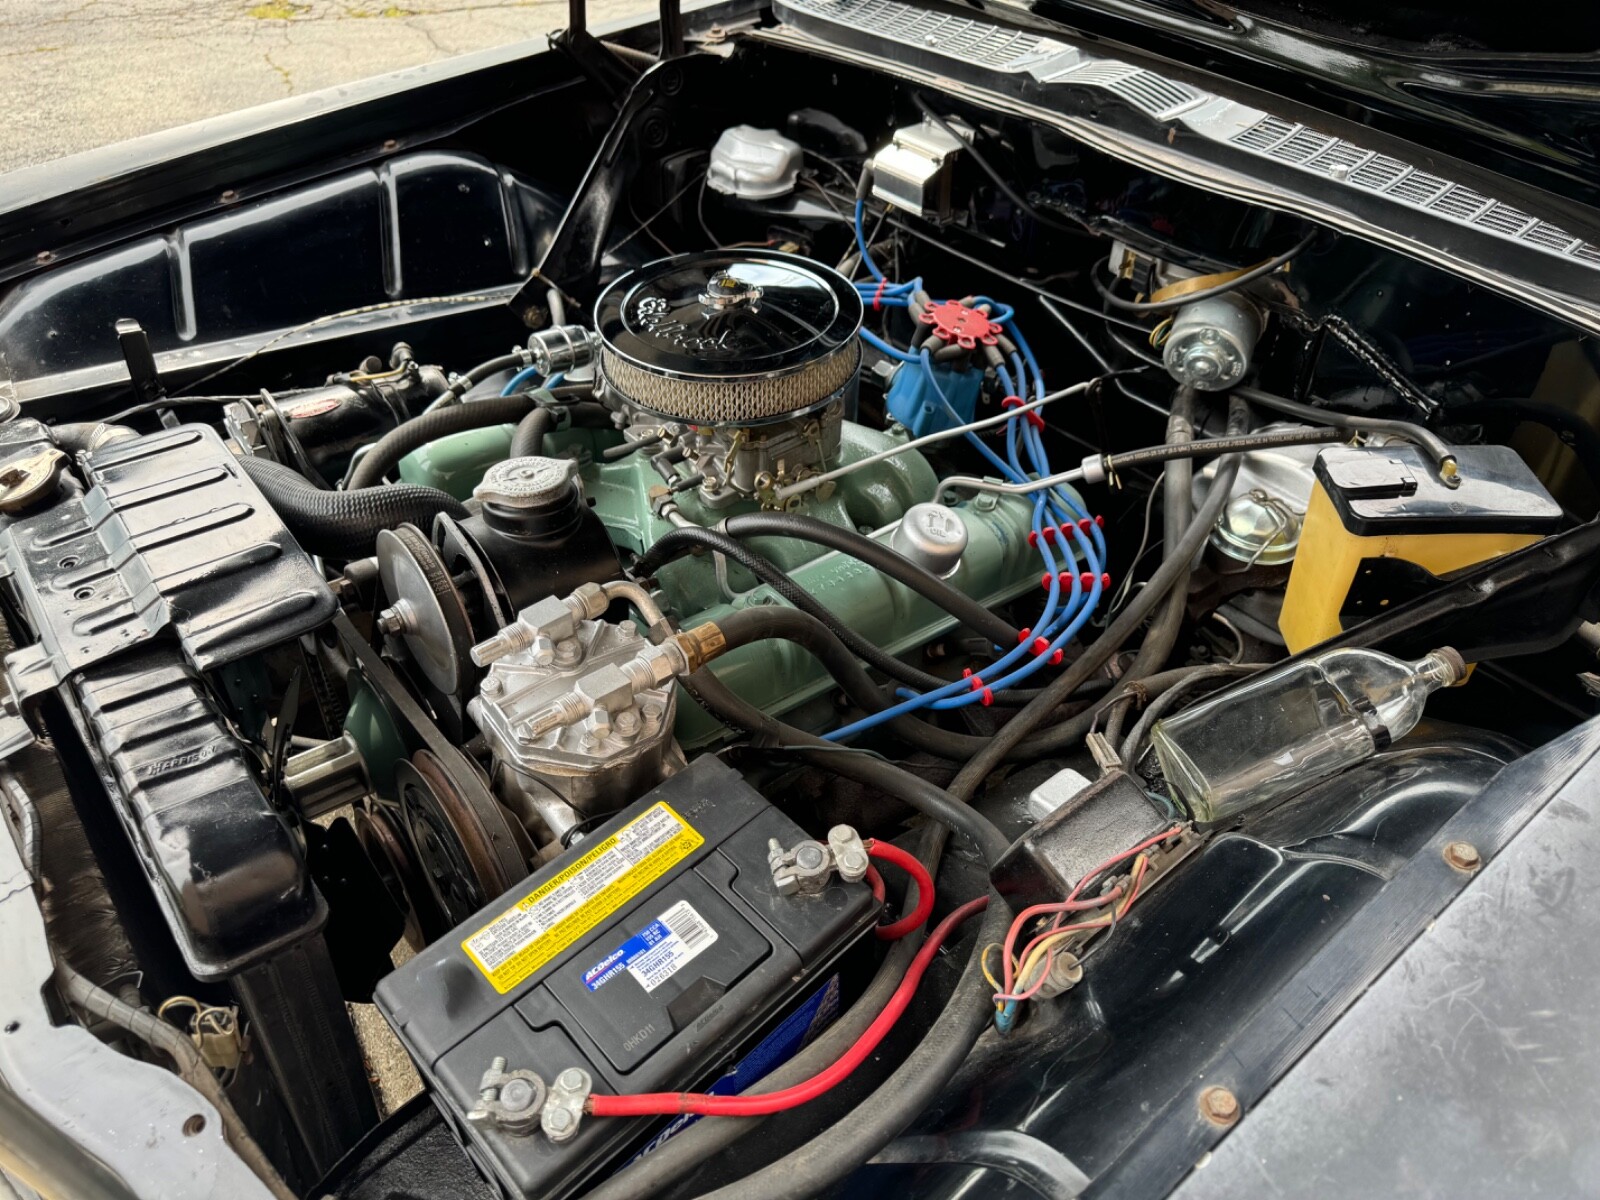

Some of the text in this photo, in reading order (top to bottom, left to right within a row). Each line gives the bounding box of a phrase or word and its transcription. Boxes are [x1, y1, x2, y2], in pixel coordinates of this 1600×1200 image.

[928, 526, 947, 538] OIL
[528, 837, 617, 904] DANGER/POISON/PELIGRO
[585, 949, 625, 981] ACDelco
[591, 962, 626, 990] 34GHR155
[641, 951, 675, 978] 34GHR155
